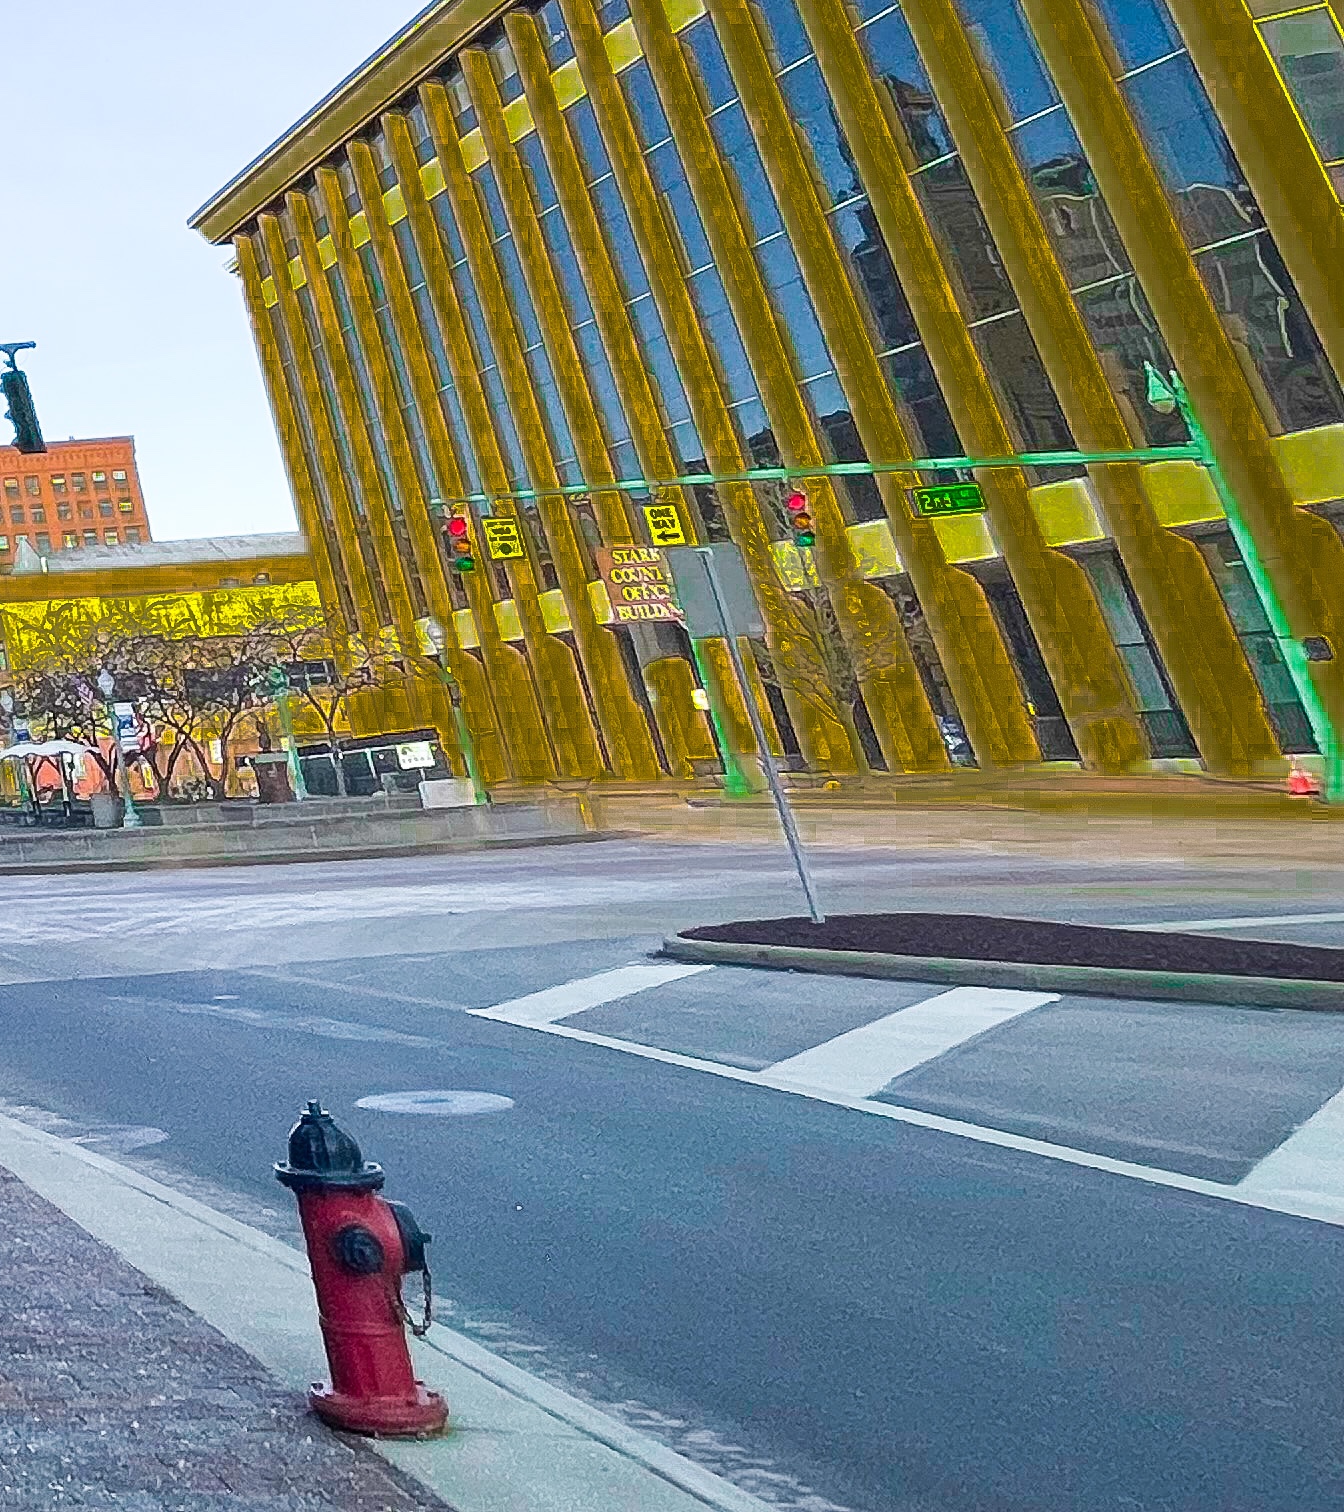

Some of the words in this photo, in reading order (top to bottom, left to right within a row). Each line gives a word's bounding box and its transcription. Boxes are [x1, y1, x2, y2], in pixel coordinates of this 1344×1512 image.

[650, 508, 673, 519] ONE
[652, 519, 676, 529] WAY
[612, 548, 660, 564] STARK
[611, 567, 669, 583] COUNT
